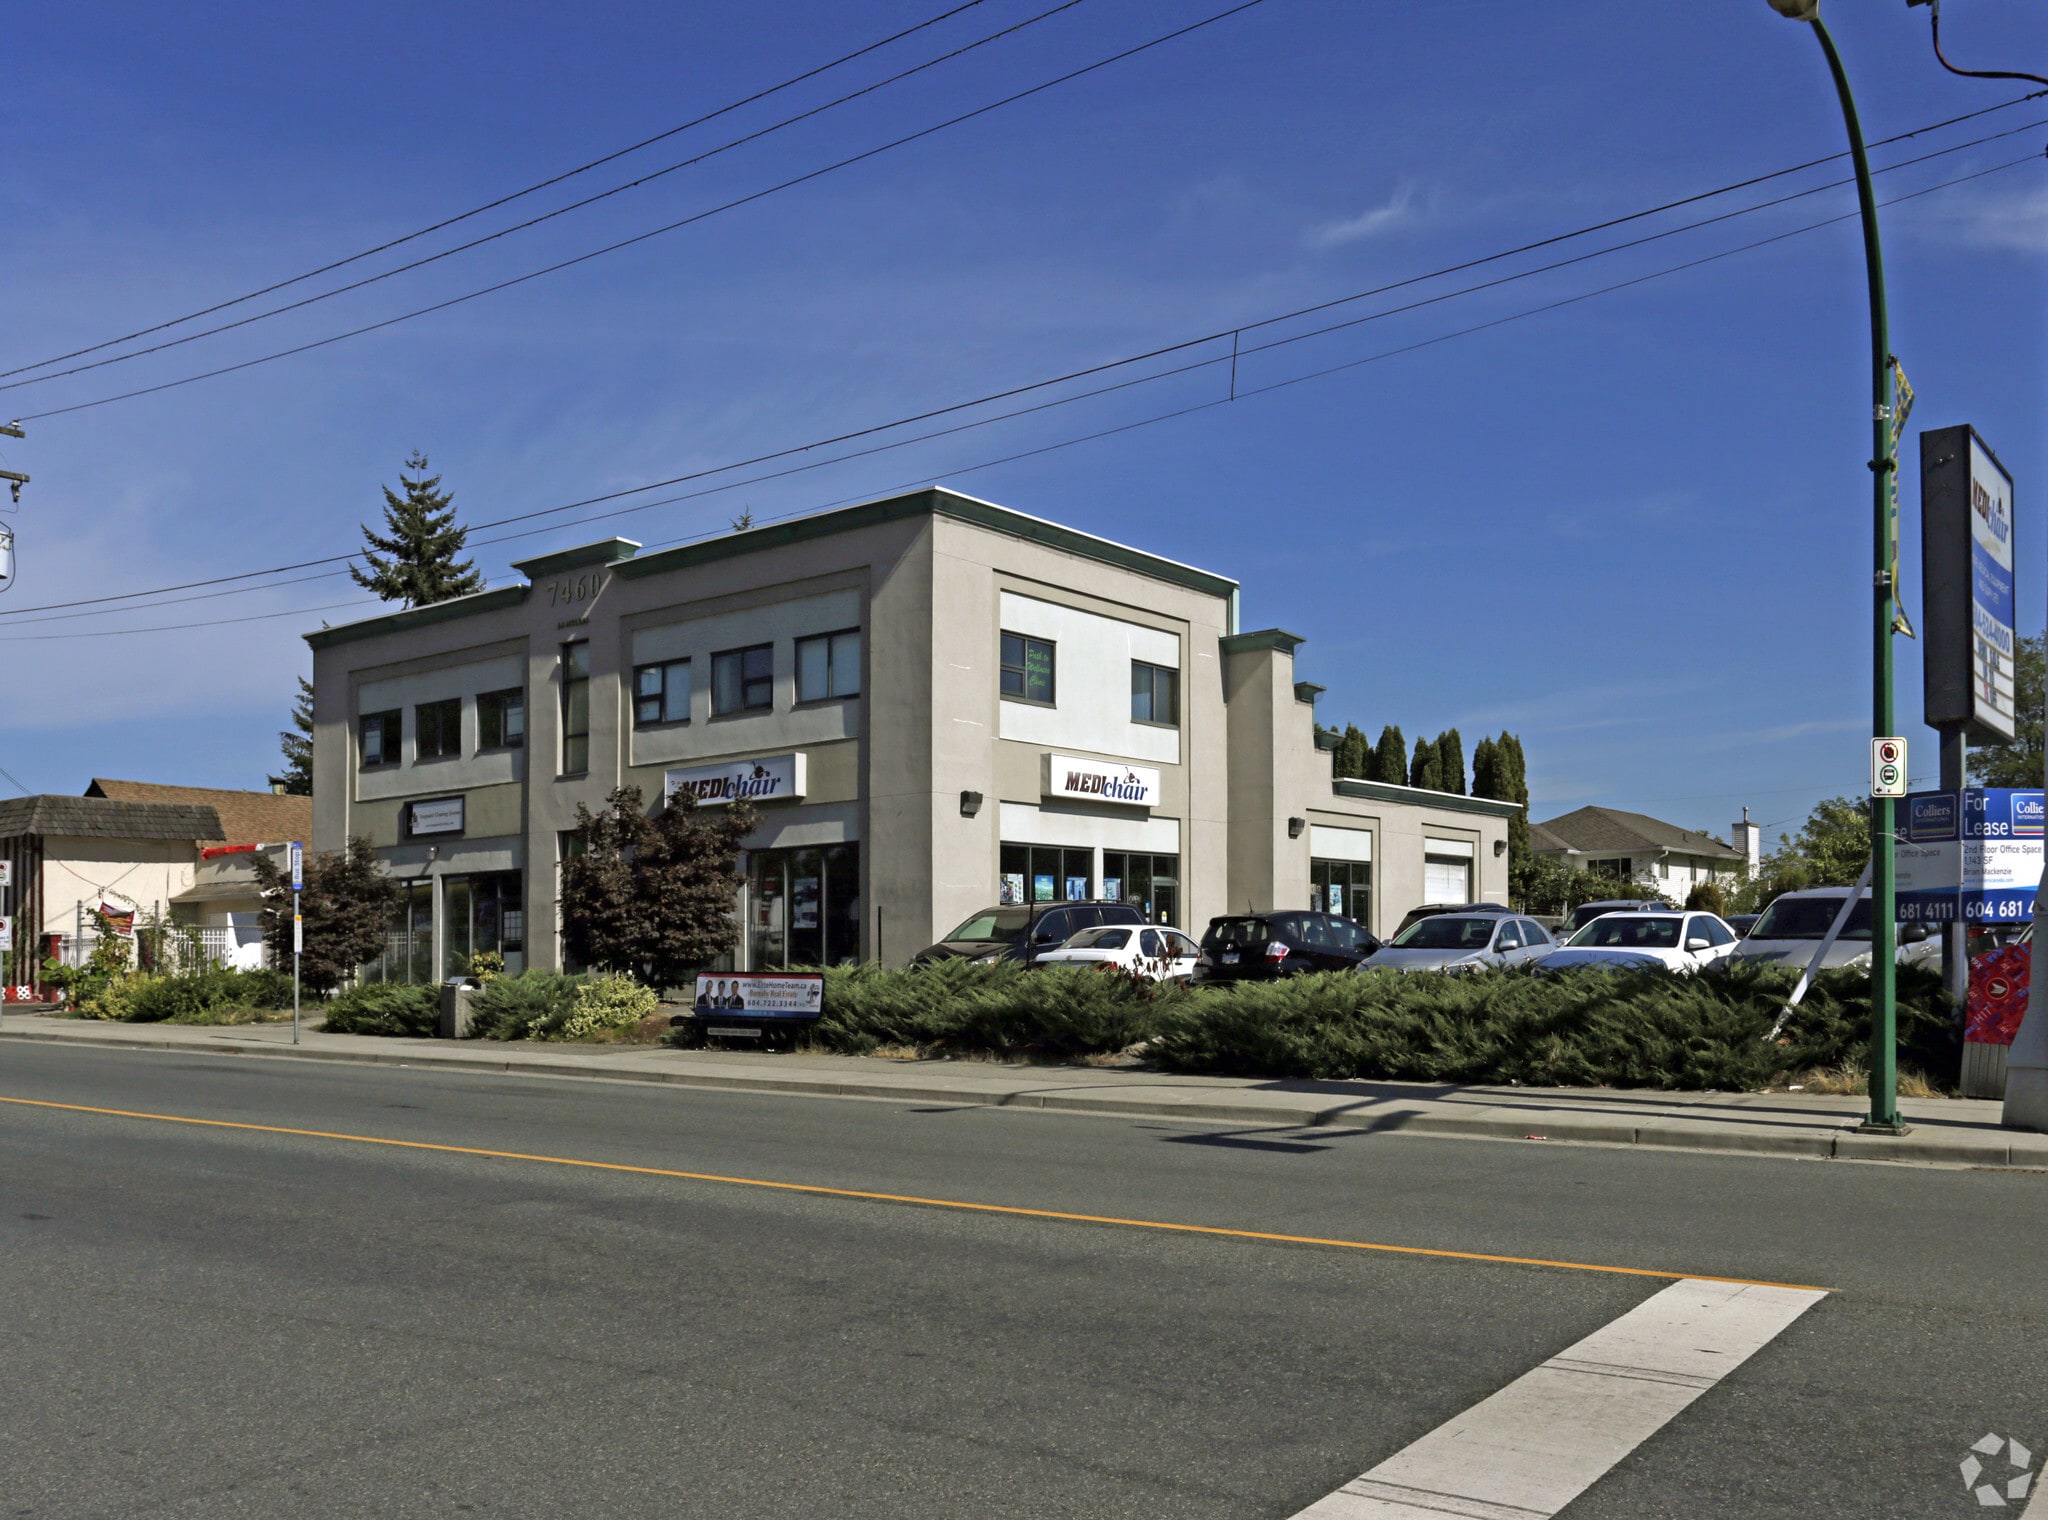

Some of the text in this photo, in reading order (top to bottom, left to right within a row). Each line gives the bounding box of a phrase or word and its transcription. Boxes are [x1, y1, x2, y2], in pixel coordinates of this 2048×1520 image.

[547, 572, 602, 608] 7460
[1065, 771, 1148, 801] MEDIchair
[1964, 792, 1989, 811] For
[1915, 804, 1951, 818] Colliers
[1964, 818, 2008, 836] Lease
[1964, 845, 2042, 856] 2nd Floor Office Space
[1984, 856, 1993, 865] SF
[1900, 902, 1953, 919] 681 4111
[1966, 902, 1994, 918] 604
[1999, 900, 2023, 917] 681
